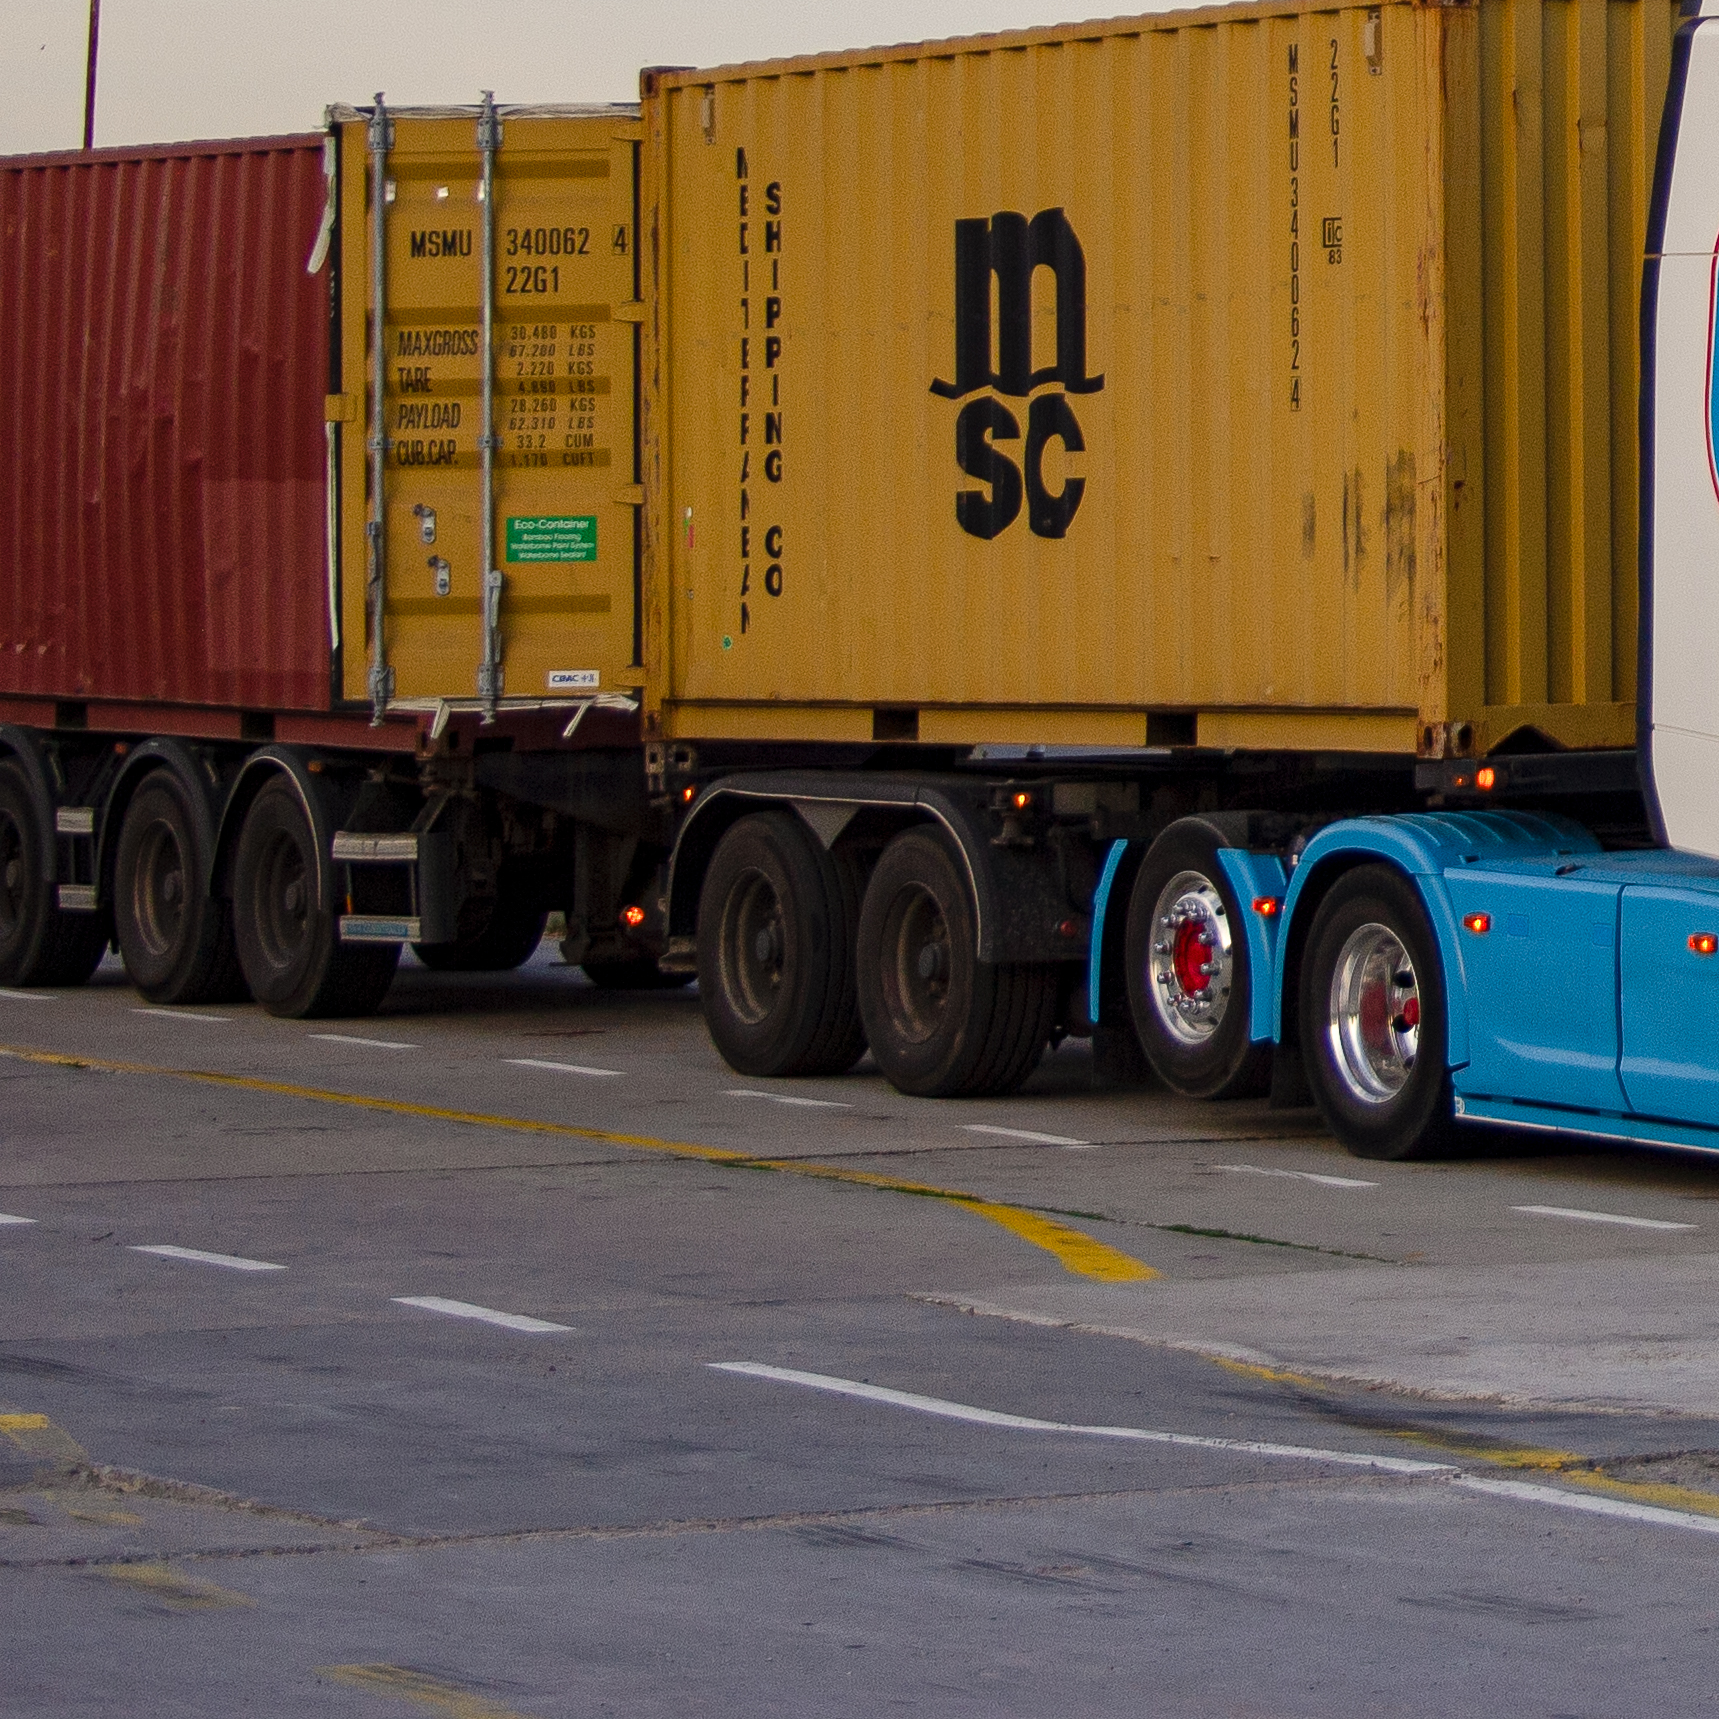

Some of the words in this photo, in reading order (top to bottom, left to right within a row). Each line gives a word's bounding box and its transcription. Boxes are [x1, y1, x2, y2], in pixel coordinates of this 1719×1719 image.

[1330, 38, 1340, 168] 22G1
[410, 230, 472, 258] MSMU
[506, 227, 591, 256] 340062
[614, 226, 629, 254] 4
[1329, 249, 1342, 265] 83
[505, 265, 560, 294] 22G1
[570, 324, 596, 340] KGS
[765, 181, 783, 483] SHIPPING
[397, 329, 479, 357] MAXGROSS
[568, 343, 595, 357] LBS
[568, 360, 594, 375] KGS
[398, 366, 433, 393] TARE
[569, 380, 595, 393] LBS
[569, 397, 596, 412] KGS
[398, 402, 462, 430] PAYLOAD
[568, 416, 595, 429] LBS
[565, 433, 594, 448] CUM
[562, 451, 595, 466] CUFT
[514, 519, 590, 530] Eco-Container
[764, 524, 783, 598] CO
